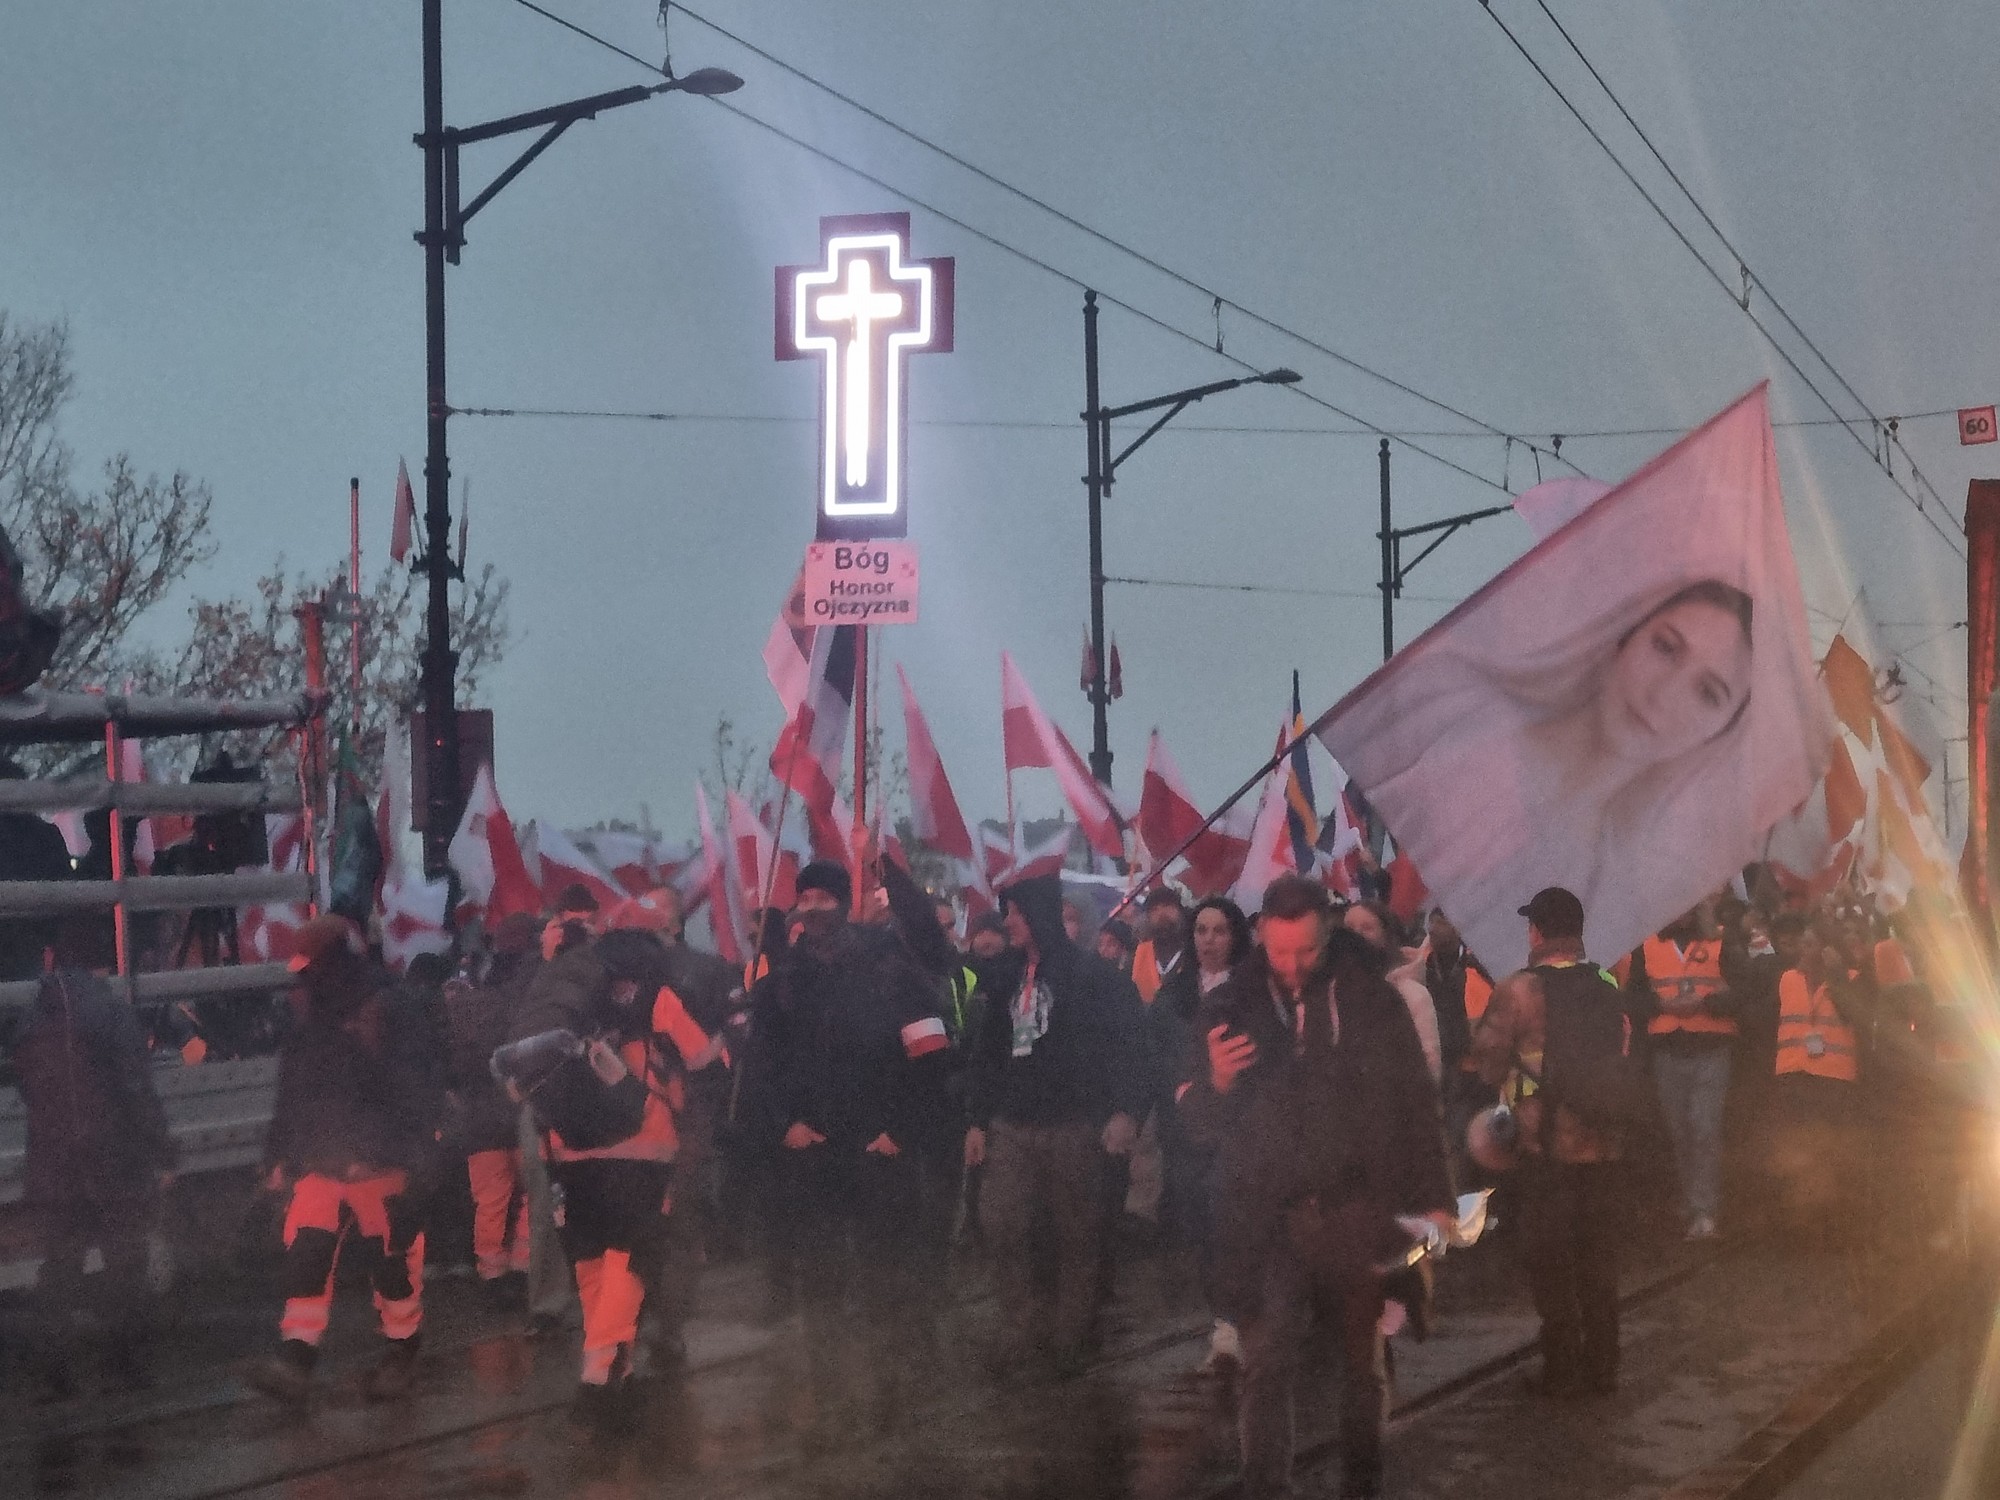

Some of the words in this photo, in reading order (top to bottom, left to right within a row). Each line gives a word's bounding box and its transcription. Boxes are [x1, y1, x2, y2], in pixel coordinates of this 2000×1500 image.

[1966, 417, 1989, 435] 60
[835, 546, 889, 574] Bóg
[830, 580, 895, 595] Honor
